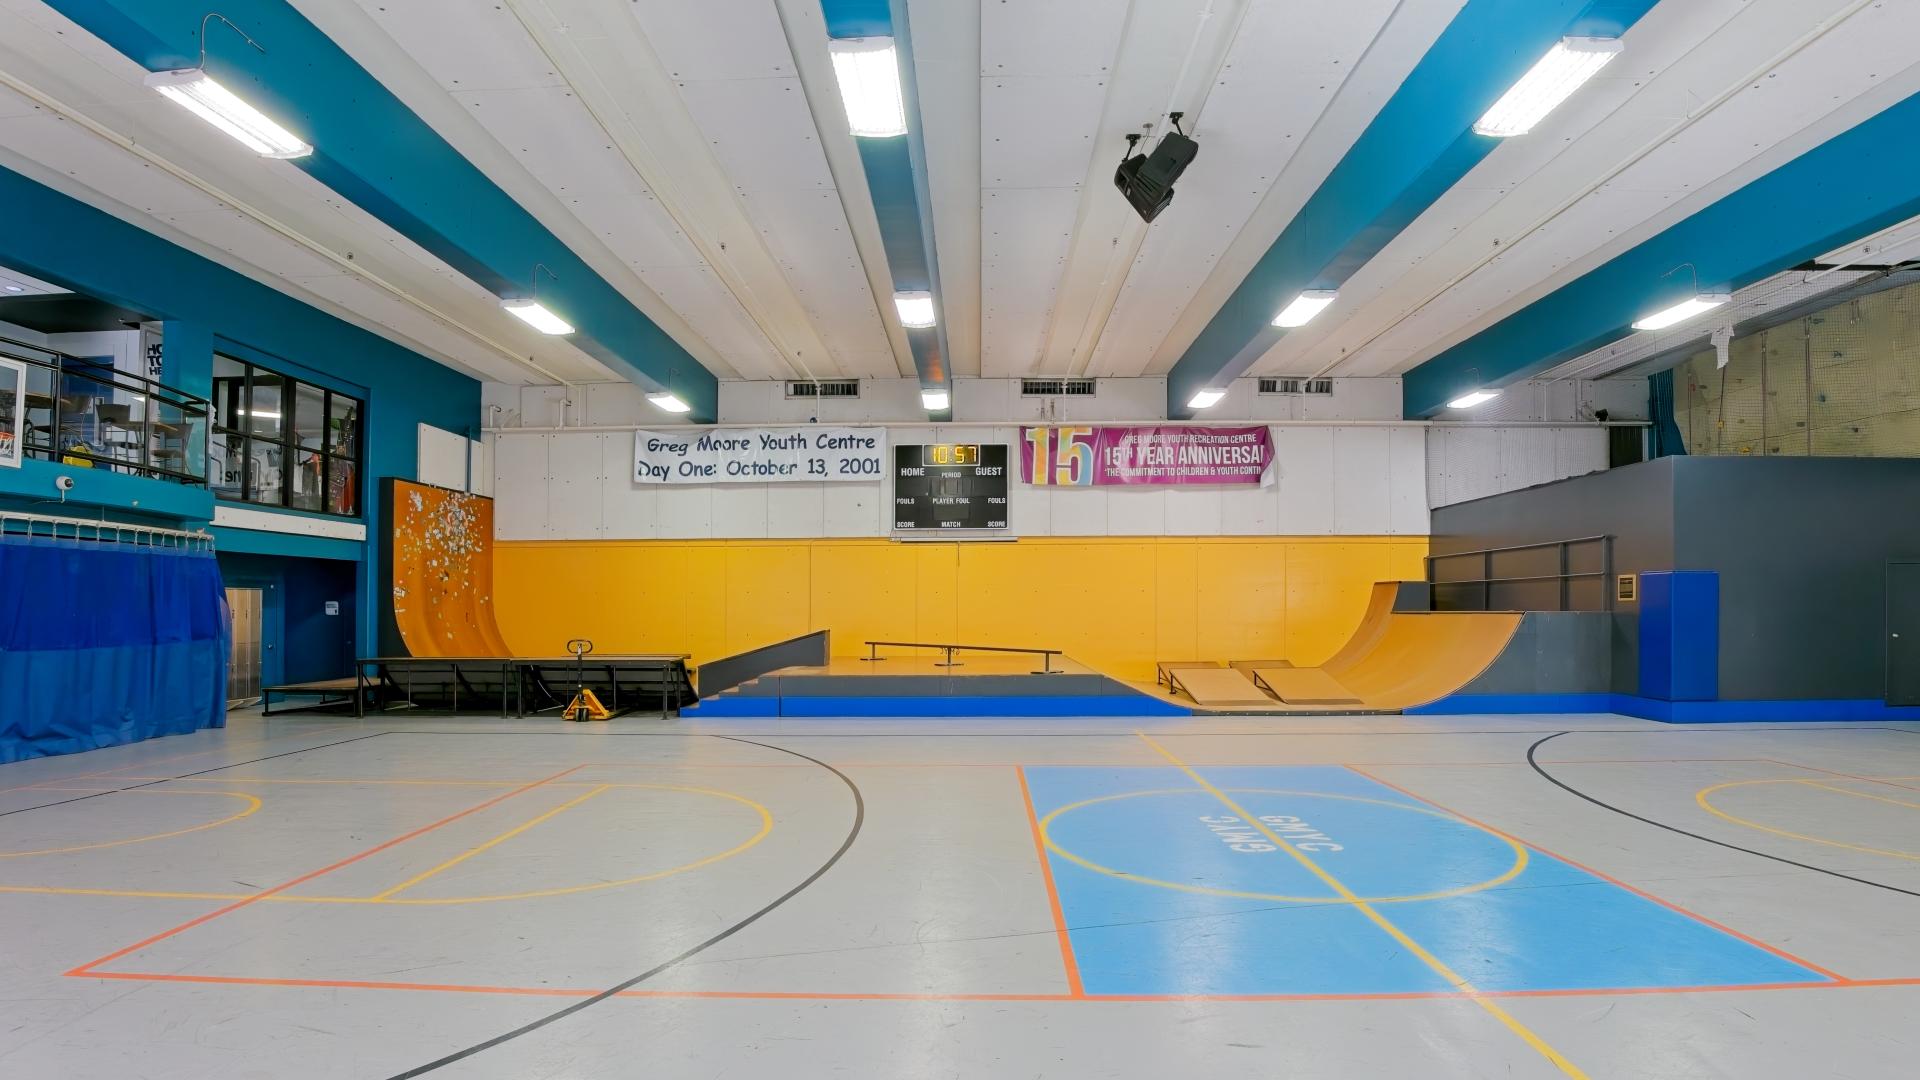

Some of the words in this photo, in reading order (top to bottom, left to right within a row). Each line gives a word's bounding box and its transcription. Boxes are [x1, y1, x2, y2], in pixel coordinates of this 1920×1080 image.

[648, 438, 688, 456] Greg
[697, 436, 750, 452] Moore
[760, 432, 807, 450] Youth
[816, 433, 876, 450] Centre
[1125, 435, 1142, 444] GREG
[1144, 435, 1164, 444] MOORE
[1167, 435, 1189, 443] YOUTH
[1190, 434, 1228, 444] RECREATION
[1231, 434, 1256, 443] CENTRE
[933, 446, 977, 464] 10:57
[1026, 427, 1094, 486] 15
[1137, 446, 1174, 464] YEAR
[638, 460, 670, 482] Day
[678, 460, 717, 476] One:
[726, 458, 798, 476] October
[808, 458, 828, 478] 13,
[840, 458, 880, 474] 2001
[901, 468, 924, 476] HOME
[976, 467, 1002, 476] GUEST
[1167, 468, 1175, 476] TO
[1176, 467, 1208, 476] CHILDREN
[1210, 466, 1215, 475] &
[1216, 466, 1238, 475] YOUTH
[1199, 816, 1277, 853] GMYC
[1258, 816, 1344, 852] GMYC
